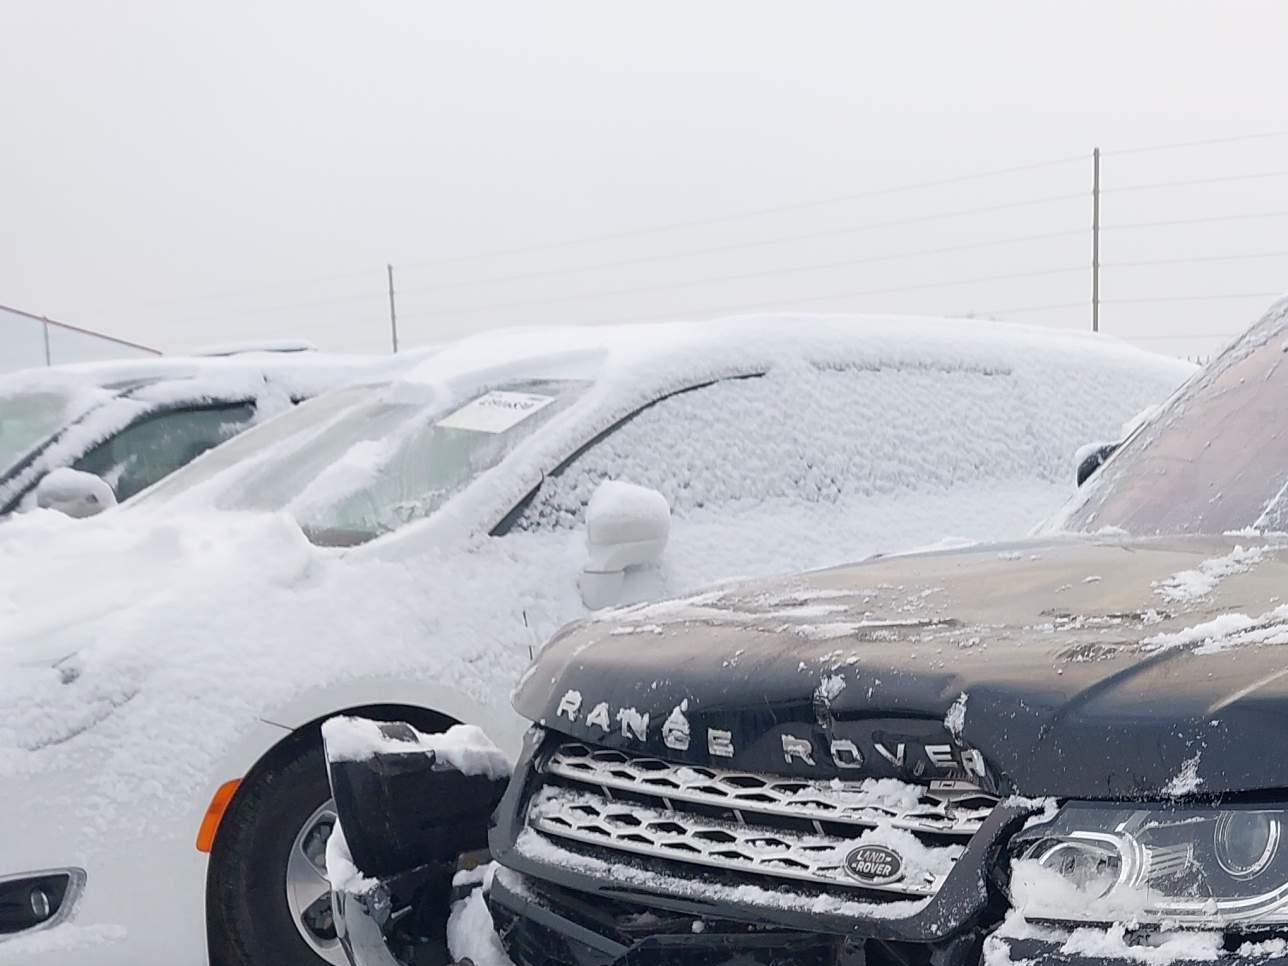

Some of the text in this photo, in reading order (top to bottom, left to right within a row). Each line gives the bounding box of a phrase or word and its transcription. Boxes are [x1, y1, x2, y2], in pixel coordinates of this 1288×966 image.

[556, 689, 986, 777] RANGE ROVER
[856, 850, 886, 863] LAND
[856, 861, 892, 876] ROVER
